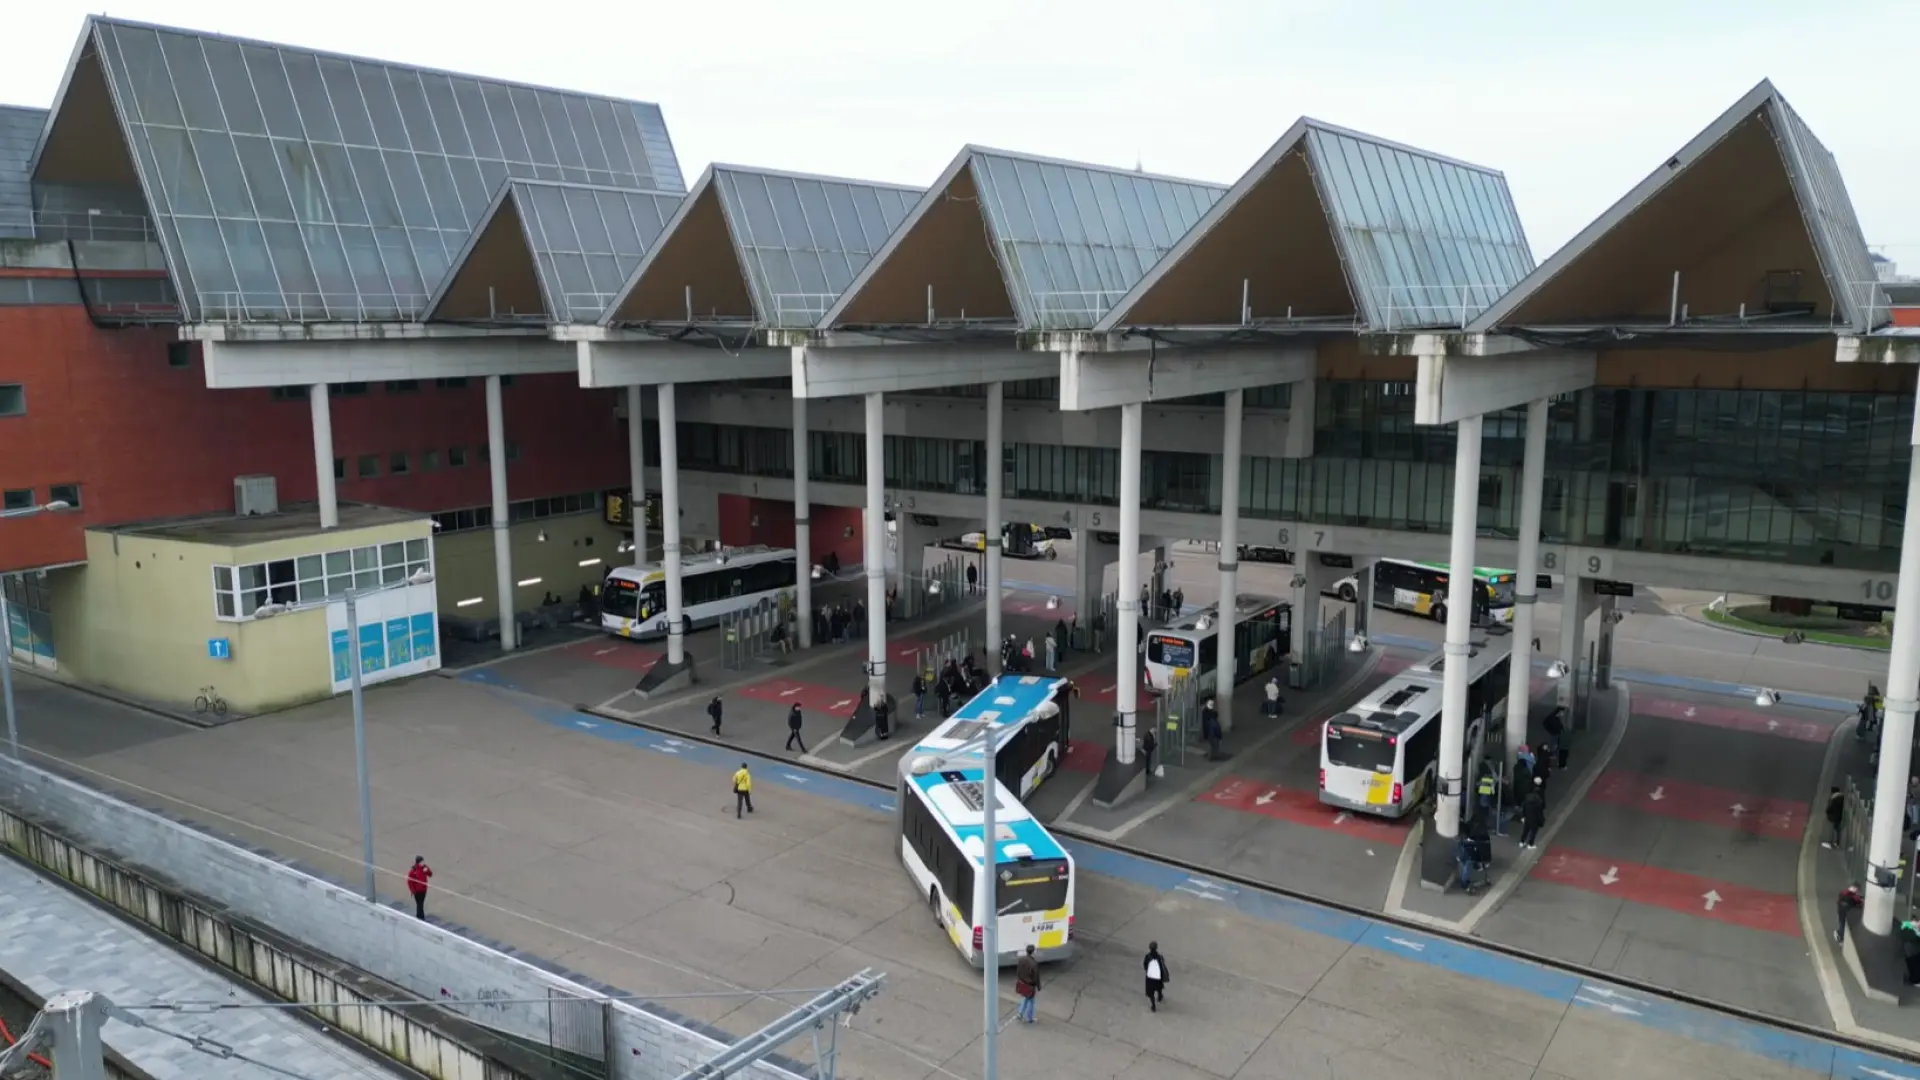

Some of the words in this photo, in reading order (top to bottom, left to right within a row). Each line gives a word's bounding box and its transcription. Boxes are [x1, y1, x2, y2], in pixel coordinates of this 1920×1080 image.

[753, 482, 759, 494] 1
[908, 496, 916, 509] 3
[1062, 510, 1071, 525] 4
[1092, 512, 1101, 527] 5
[1278, 528, 1289, 545] 6
[1314, 531, 1325, 547] 7
[1544, 552, 1557, 569] 8
[1588, 556, 1601, 574] 9
[1861, 579, 1893, 601] 10
